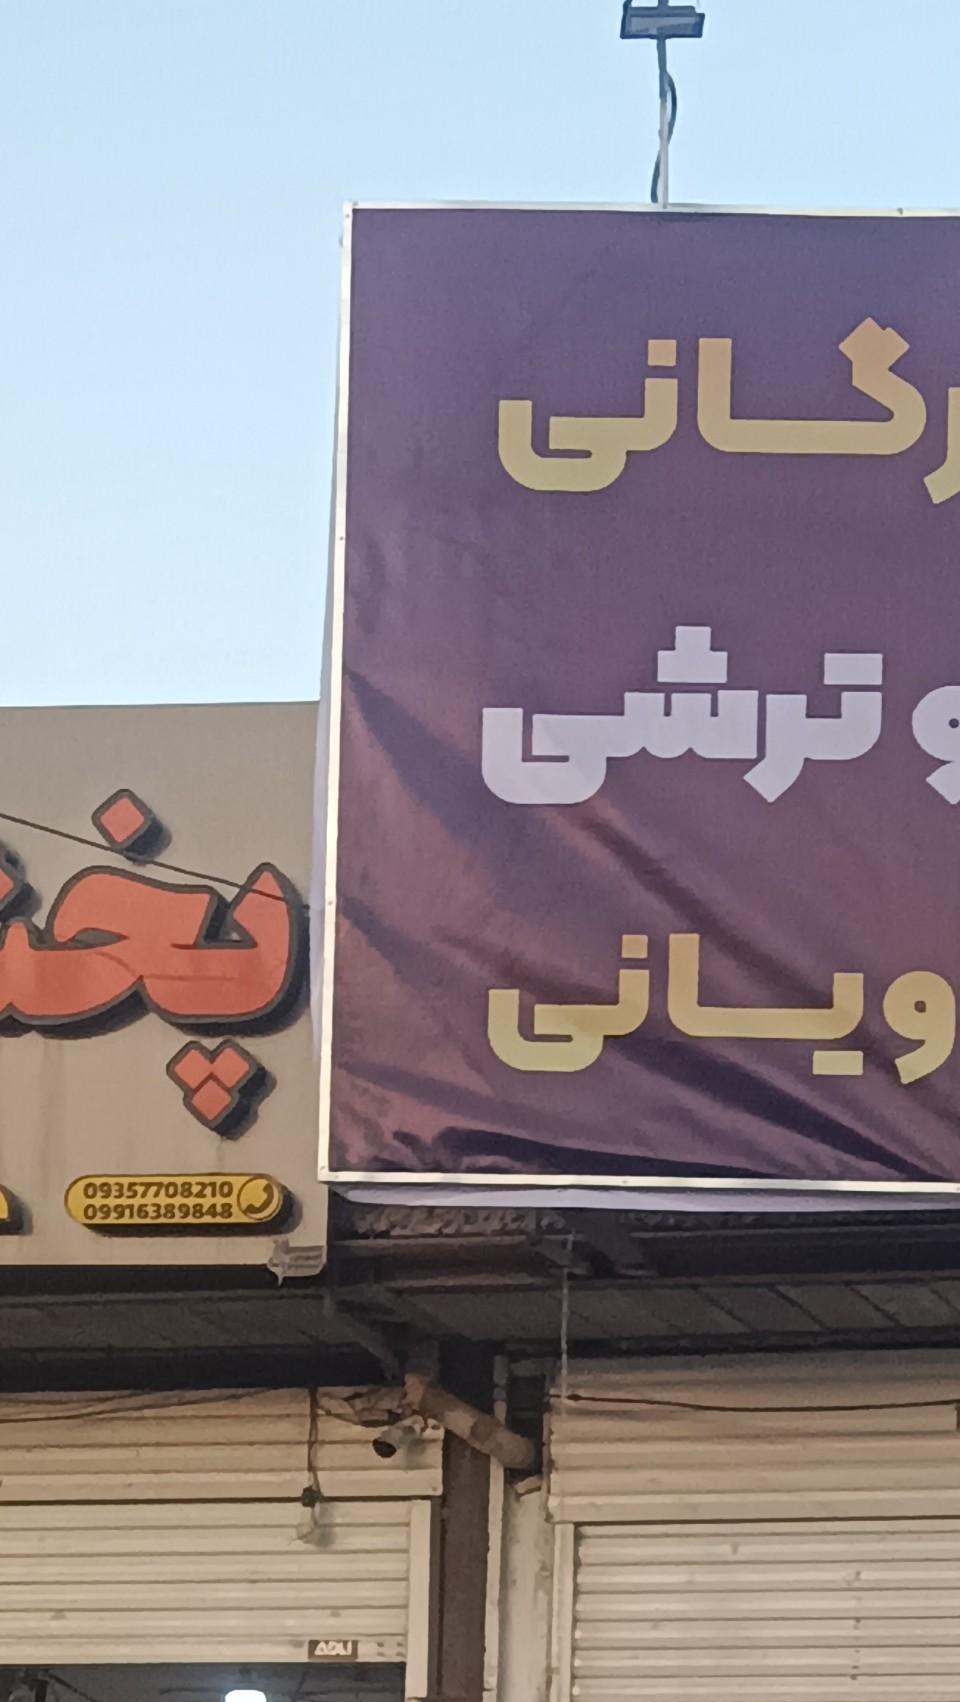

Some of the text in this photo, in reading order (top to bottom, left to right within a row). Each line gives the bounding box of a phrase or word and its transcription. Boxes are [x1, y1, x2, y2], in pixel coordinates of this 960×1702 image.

[481, 625, 884, 805] ترشی
[83, 1181, 234, 1199] 09357708210
[83, 1202, 234, 1220] 09916389848
